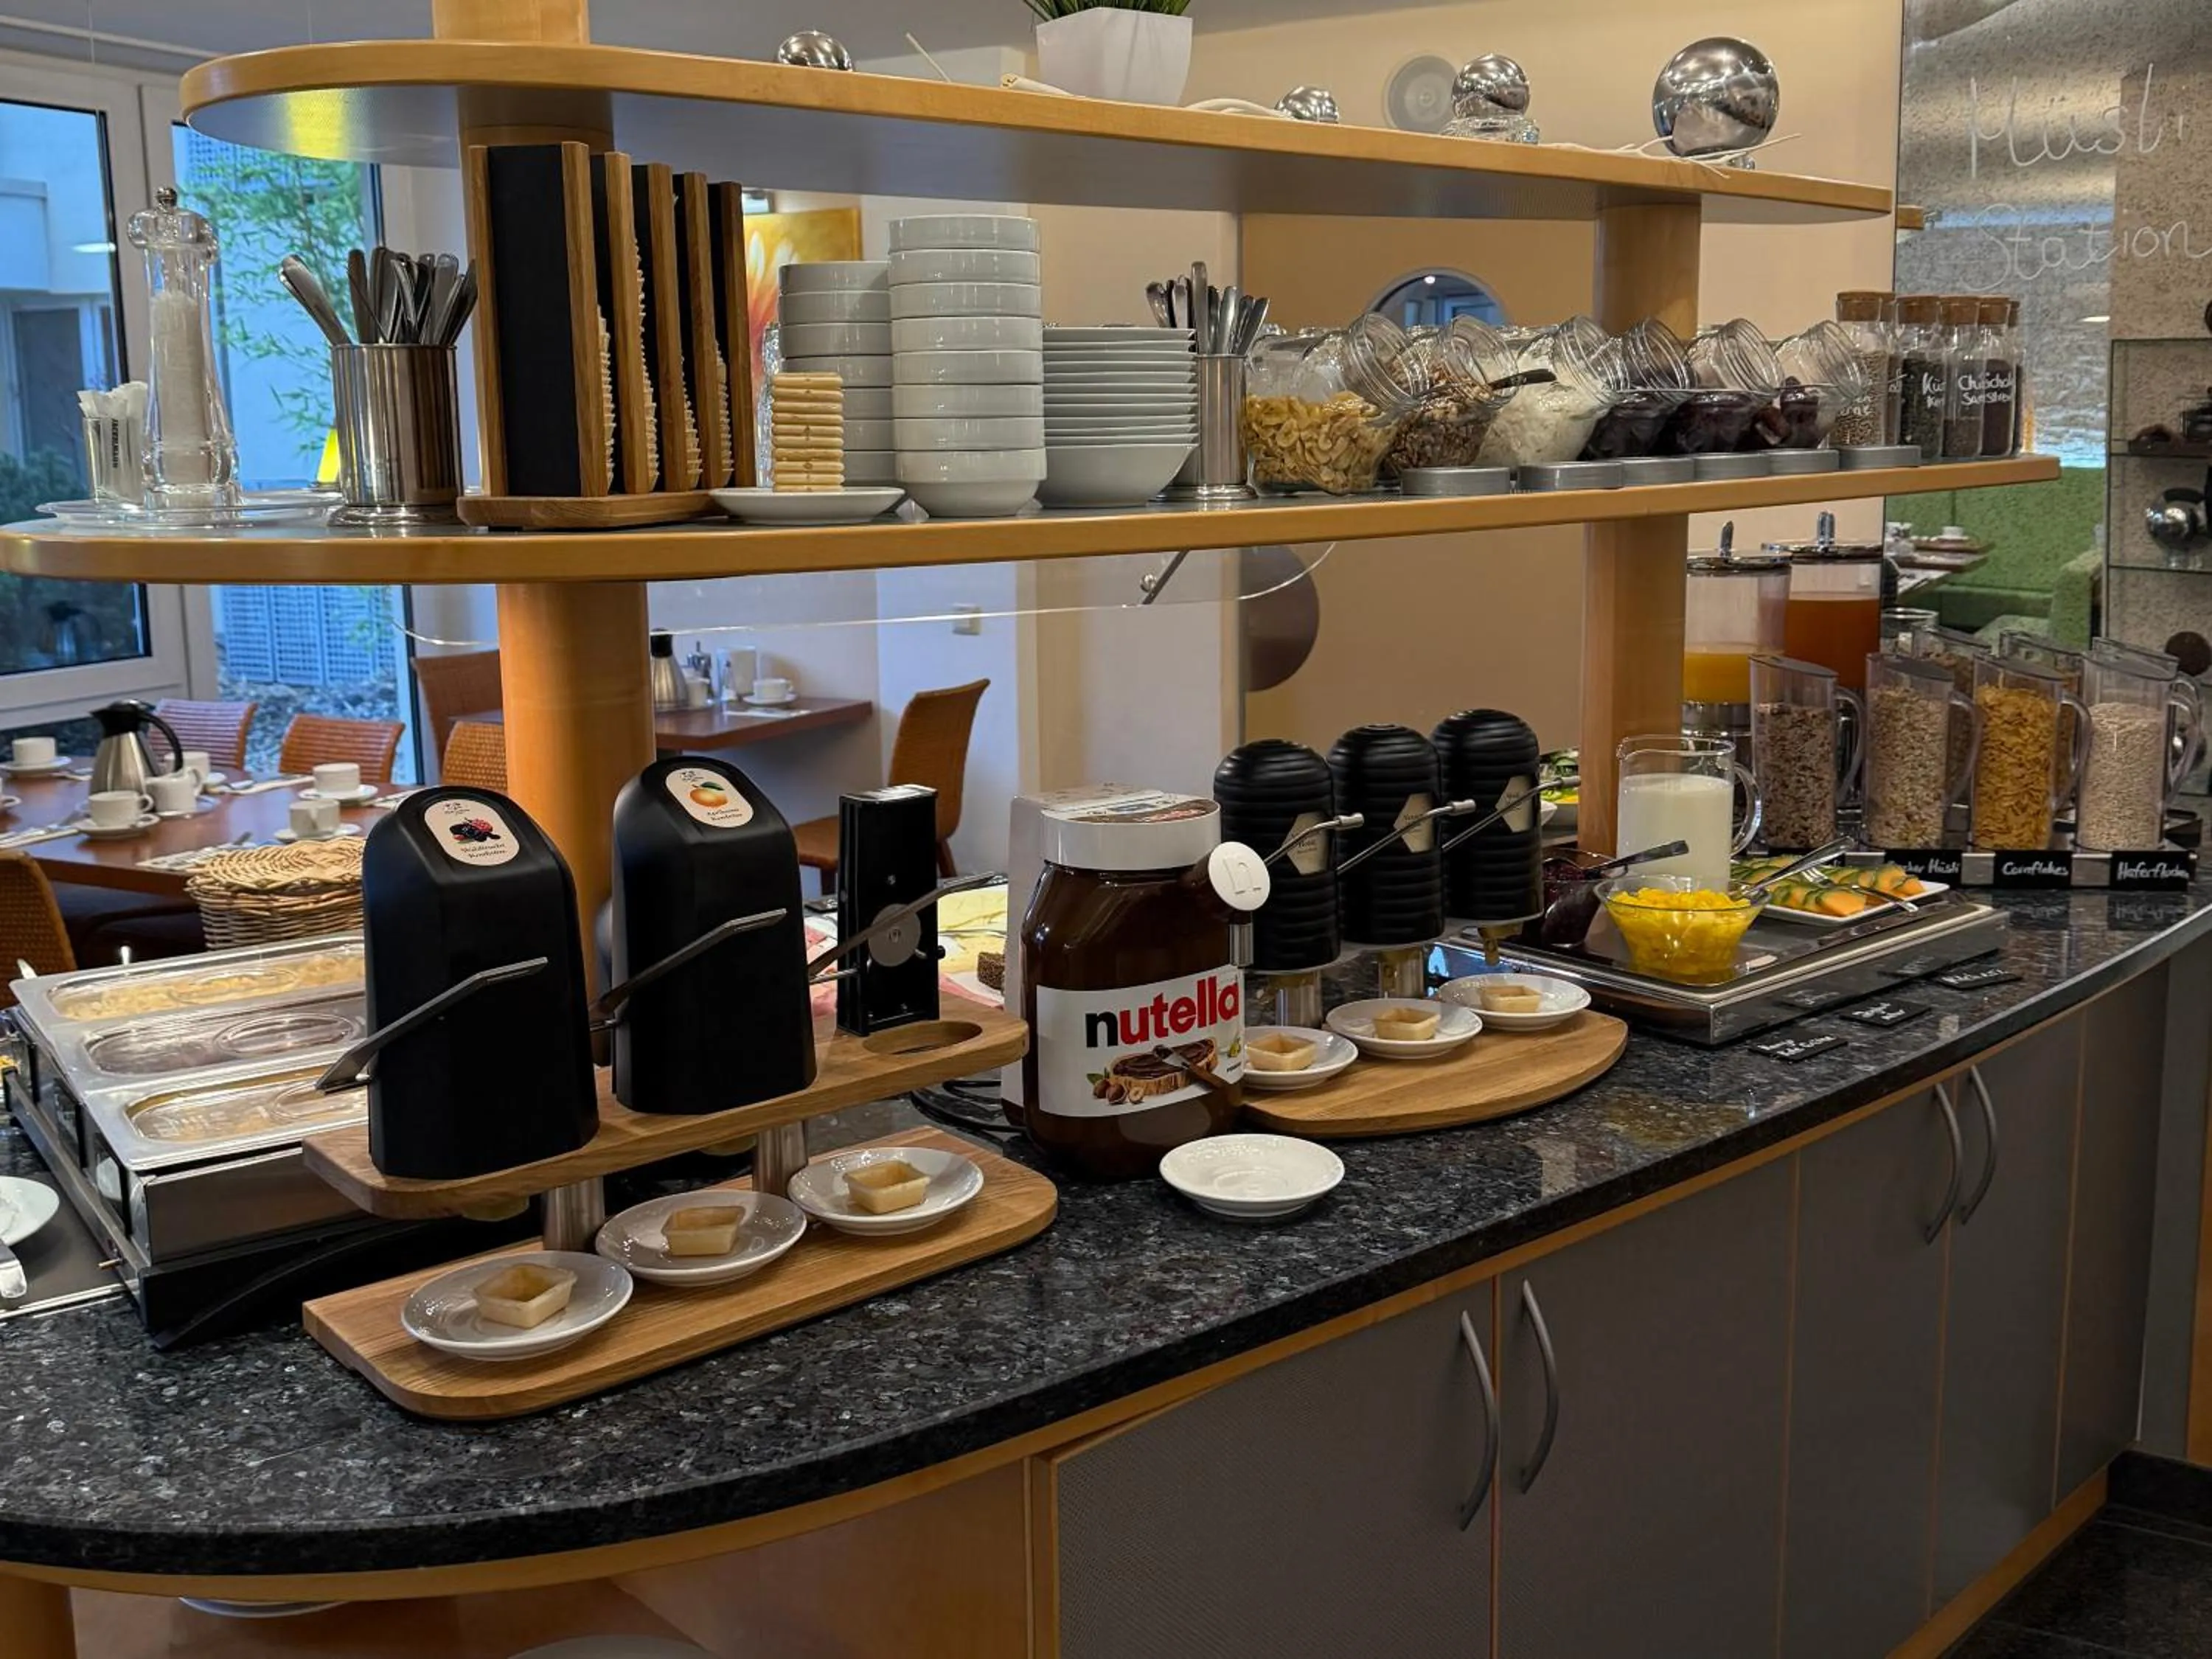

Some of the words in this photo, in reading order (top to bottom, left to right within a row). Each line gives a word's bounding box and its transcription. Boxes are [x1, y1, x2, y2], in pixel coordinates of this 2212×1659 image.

[1959, 203, 2212, 292] Station
[2001, 860, 2069, 876] Cornflakes
[1085, 975, 1239, 1048] nutella
